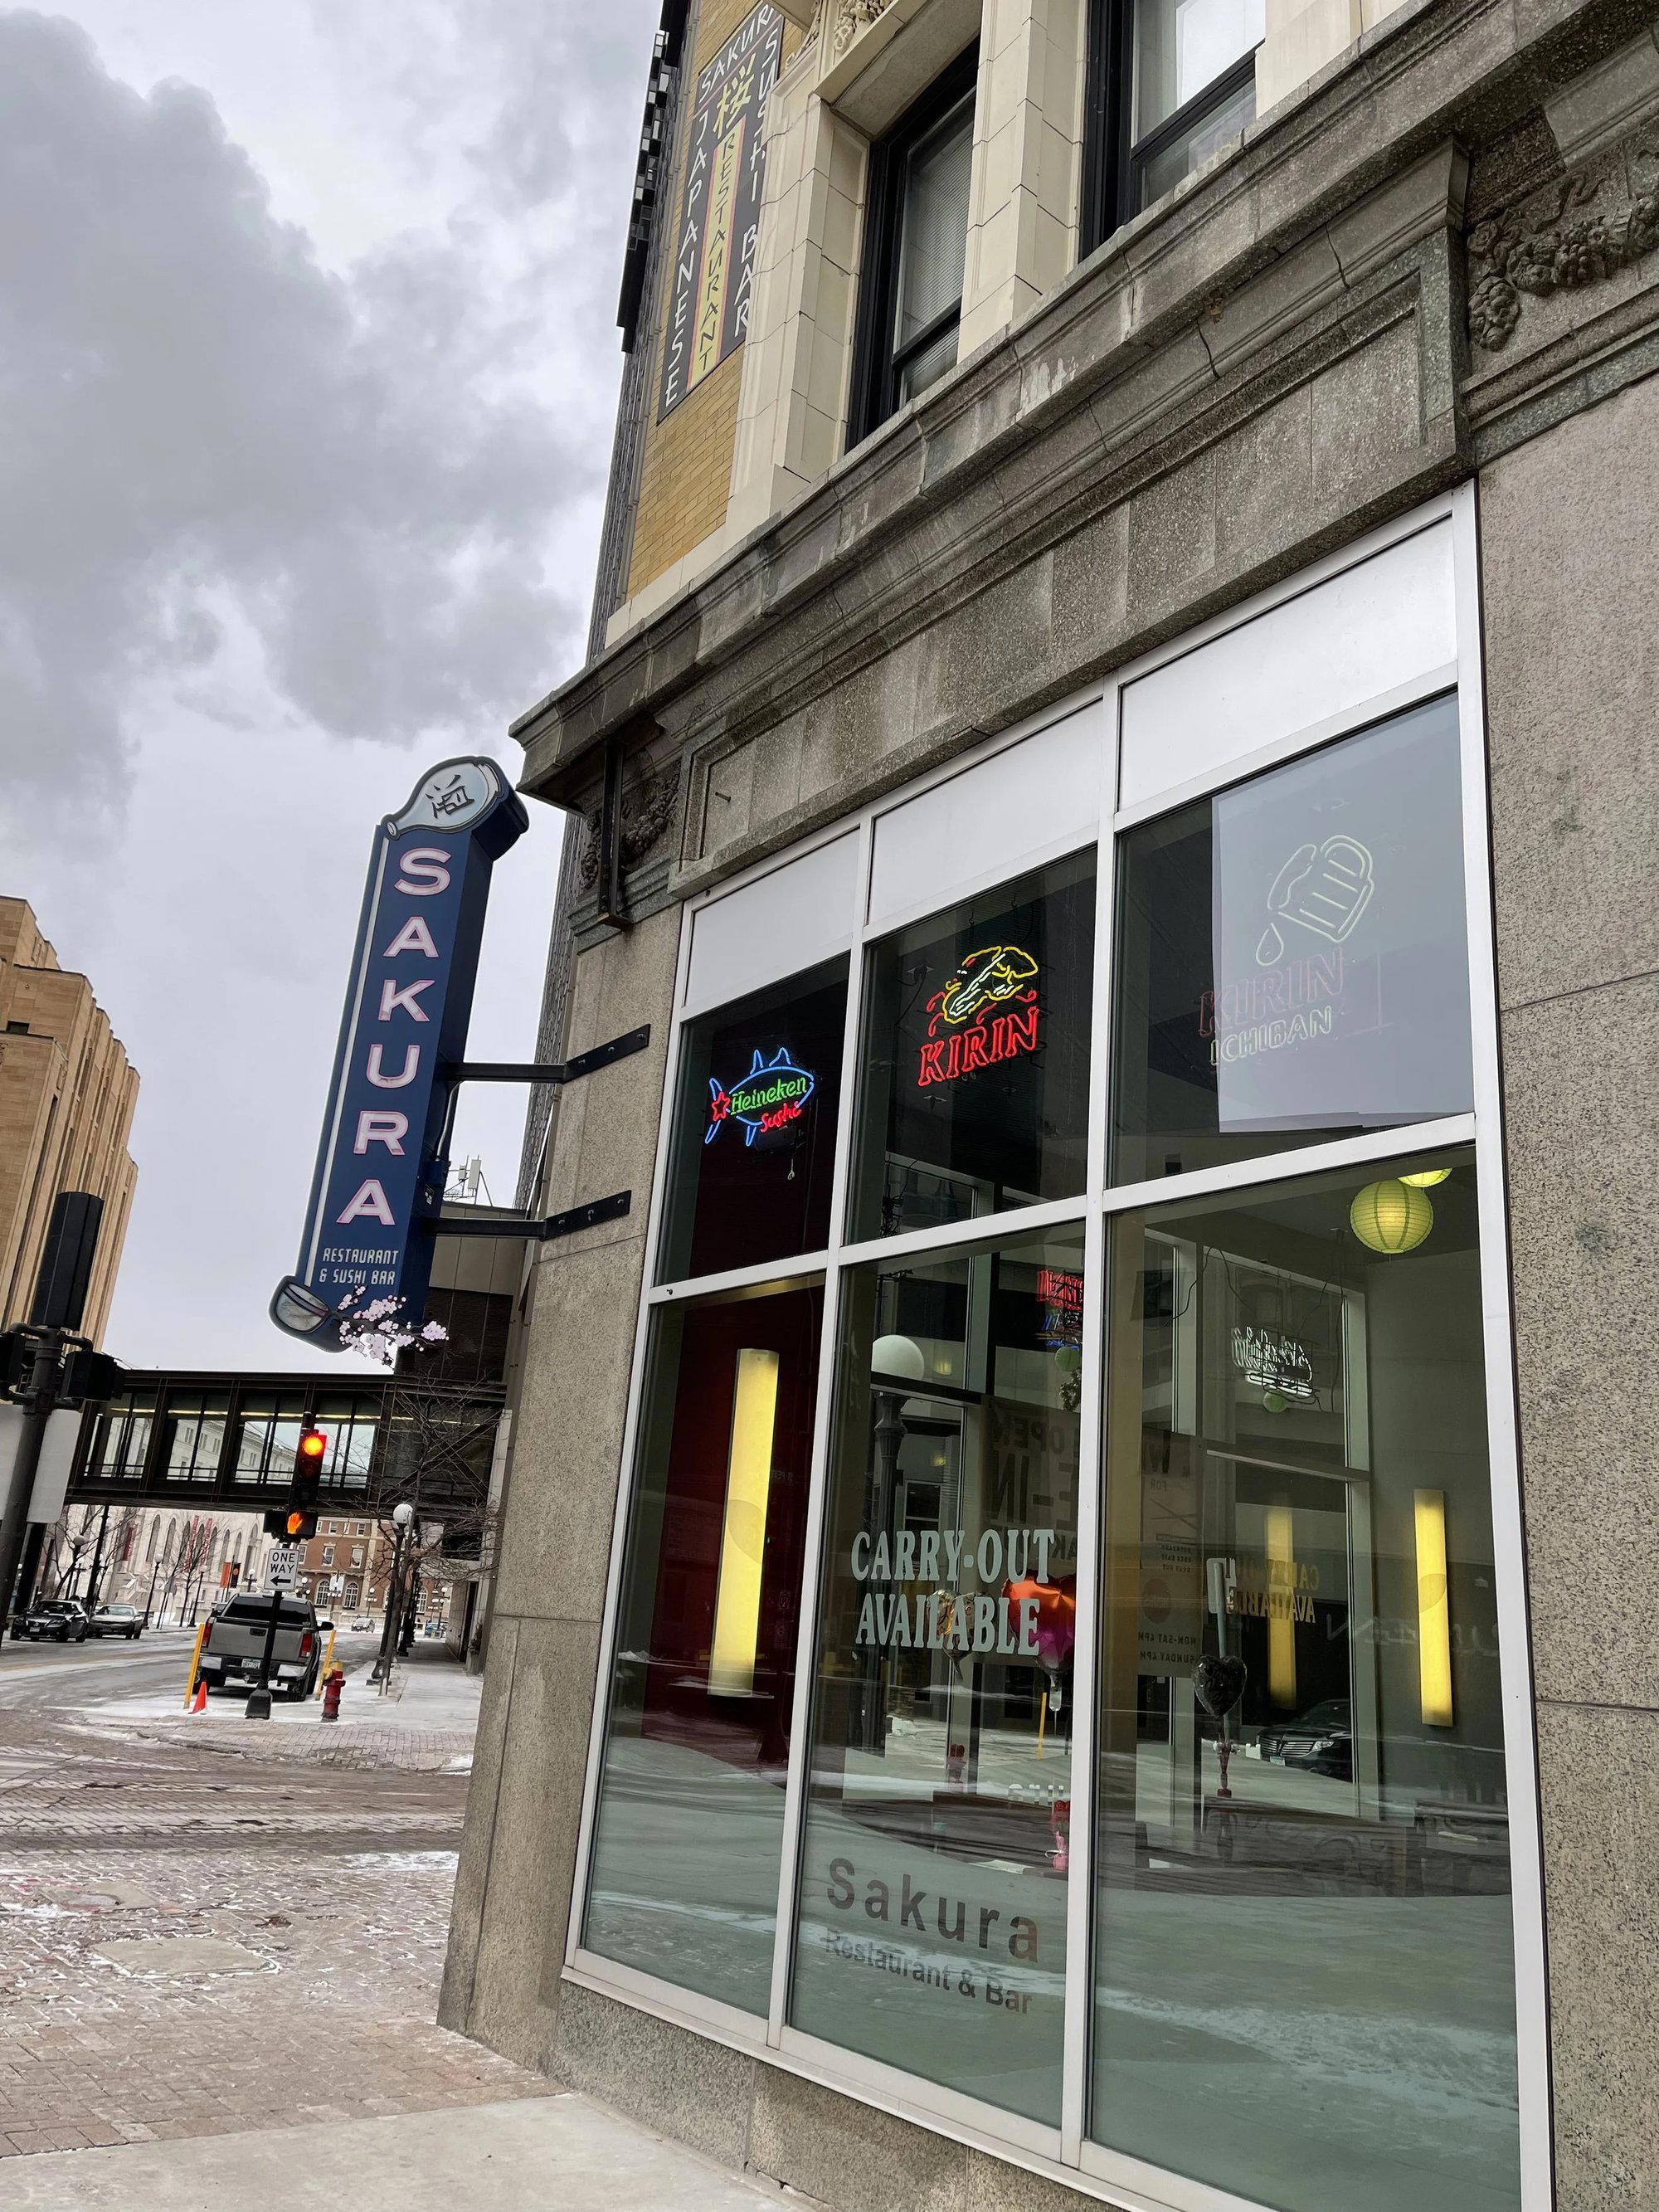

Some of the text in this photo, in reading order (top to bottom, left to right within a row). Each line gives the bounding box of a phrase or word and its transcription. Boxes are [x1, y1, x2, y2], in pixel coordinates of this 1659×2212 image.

[665, 110, 708, 407] JAPANESE
[698, 133, 736, 372] RESTAURANT
[734, 223, 758, 338] BAR
[1198, 947, 1345, 1038] KIRIN
[336, 846, 452, 1226] SAKURA
[917, 1006, 1039, 1087] KIRIN
[1209, 1005, 1333, 1066] ICHIBAN
[731, 1077, 807, 1115] Heineken
[319, 1268, 396, 1285] & SUSHI BAR
[322, 1247, 399, 1264] RESTAURANT
[270, 1563, 294, 1574] WAY
[272, 1552, 295, 1562] ONE
[855, 1592, 1040, 1656] AVAILABLE
[826, 1857, 1039, 1963] Sakura
[825, 1927, 1033, 2015] Restaurant & Bar
